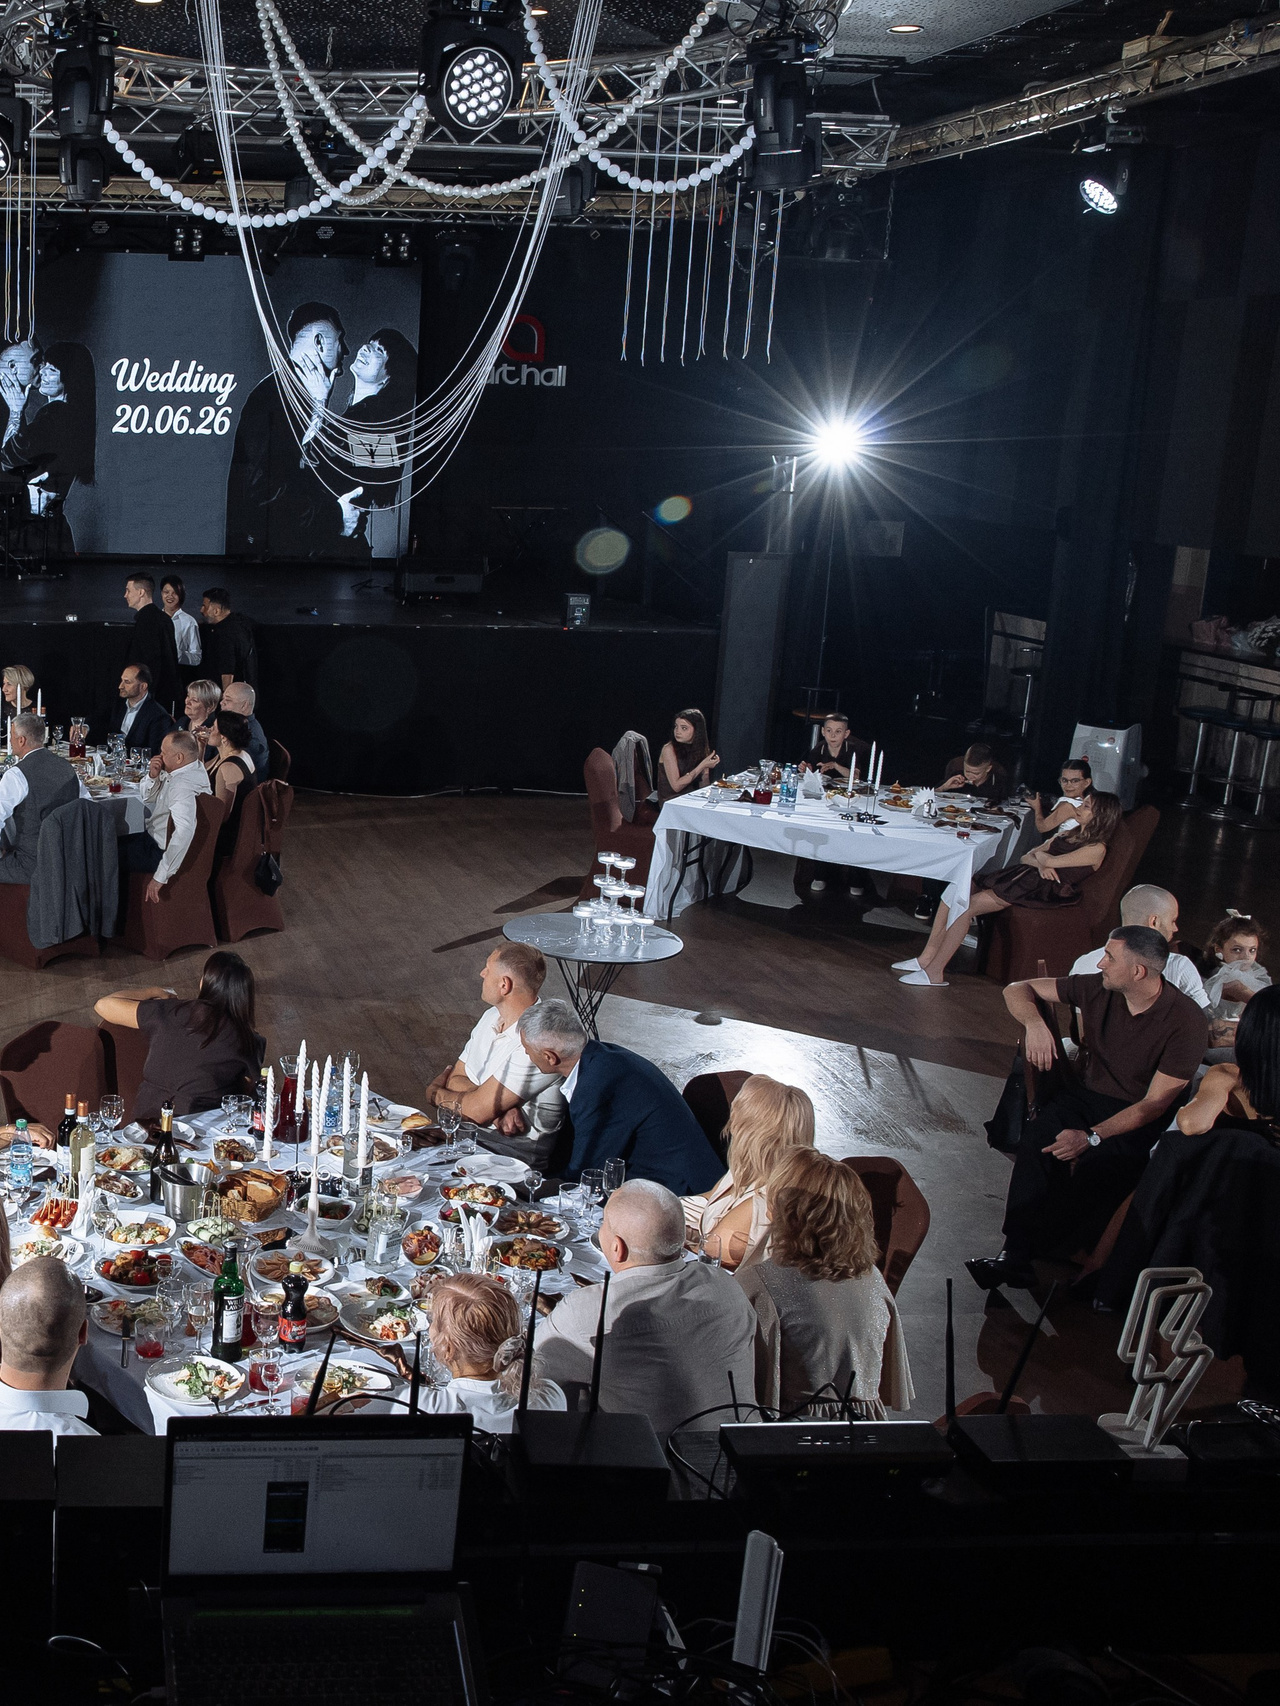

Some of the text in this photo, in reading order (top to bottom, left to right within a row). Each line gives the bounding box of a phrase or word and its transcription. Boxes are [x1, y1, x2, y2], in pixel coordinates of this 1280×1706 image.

[110, 358, 237, 406] Wedding
[520, 364, 567, 386] hall
[112, 404, 232, 435] 20.06.26
